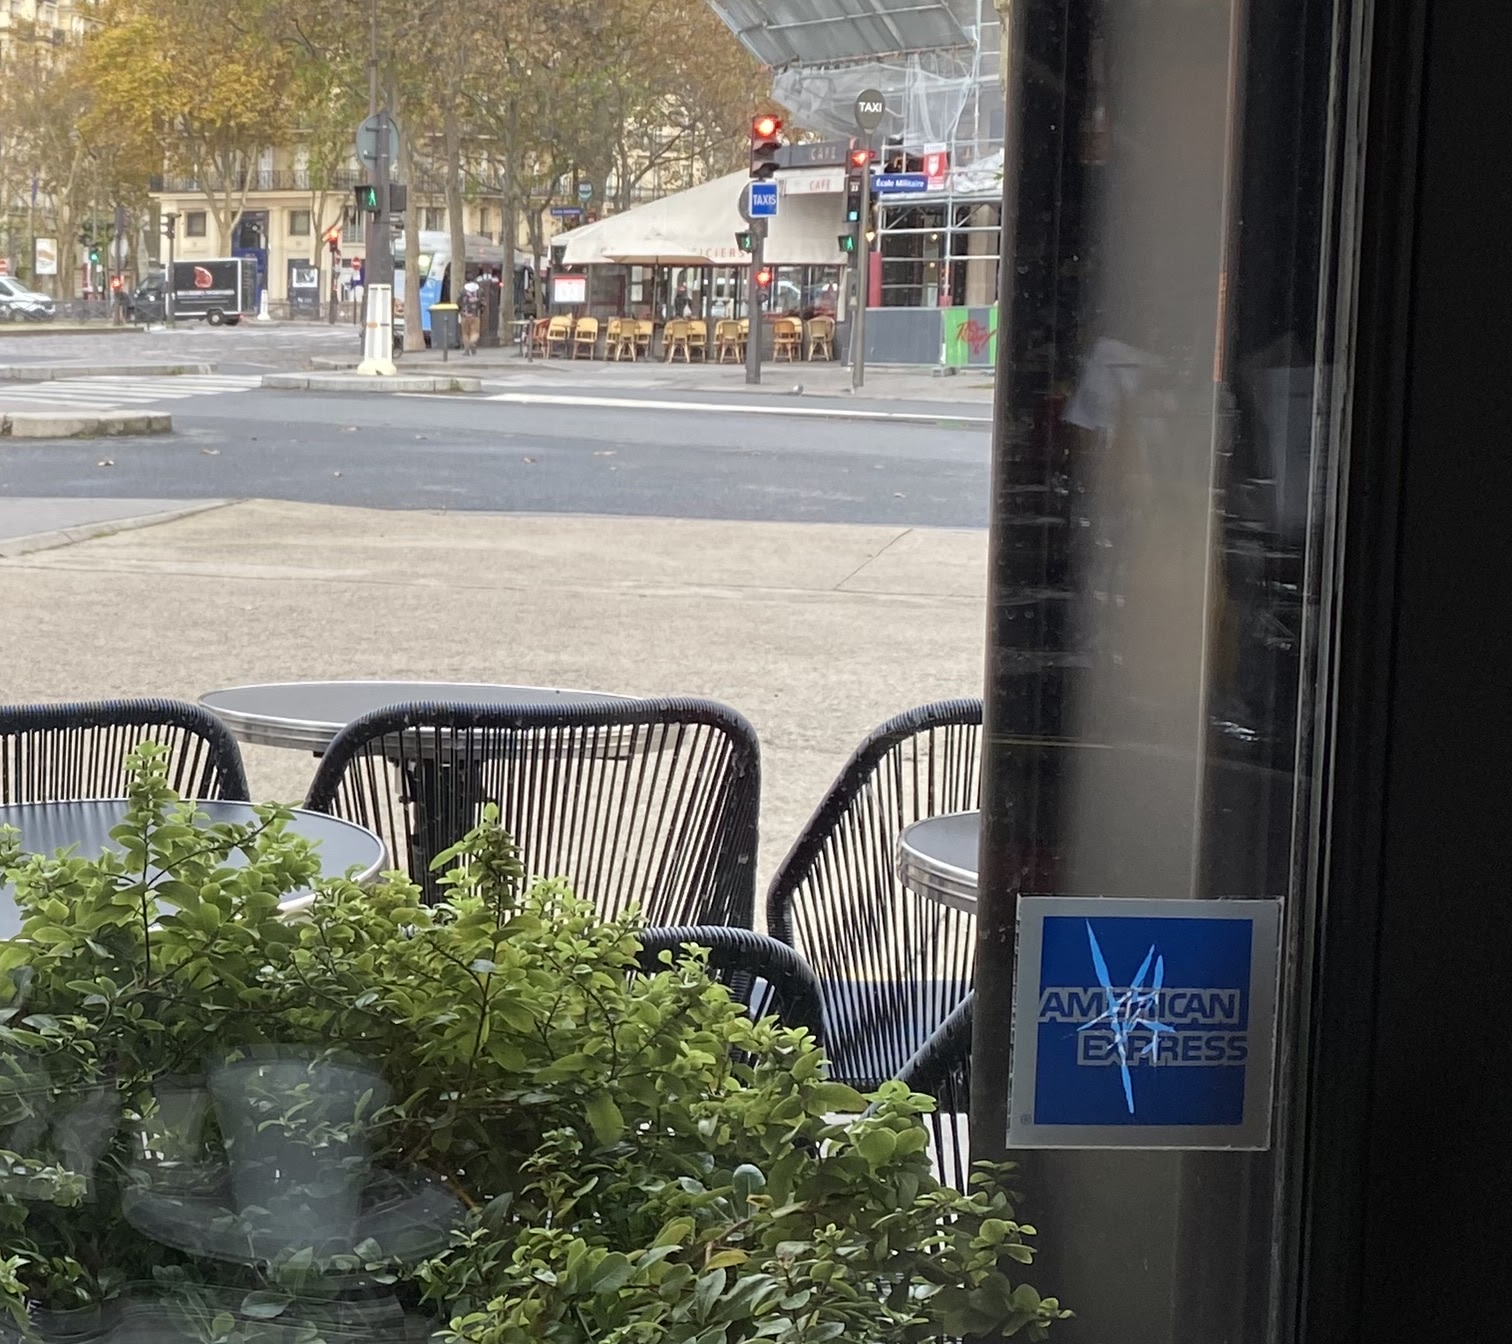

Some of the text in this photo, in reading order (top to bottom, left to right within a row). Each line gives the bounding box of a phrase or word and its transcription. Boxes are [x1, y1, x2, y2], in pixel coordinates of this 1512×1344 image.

[858, 102, 882, 112] TAXI
[876, 178, 925, 188] École Militaire
[752, 194, 777, 205] TAXIS
